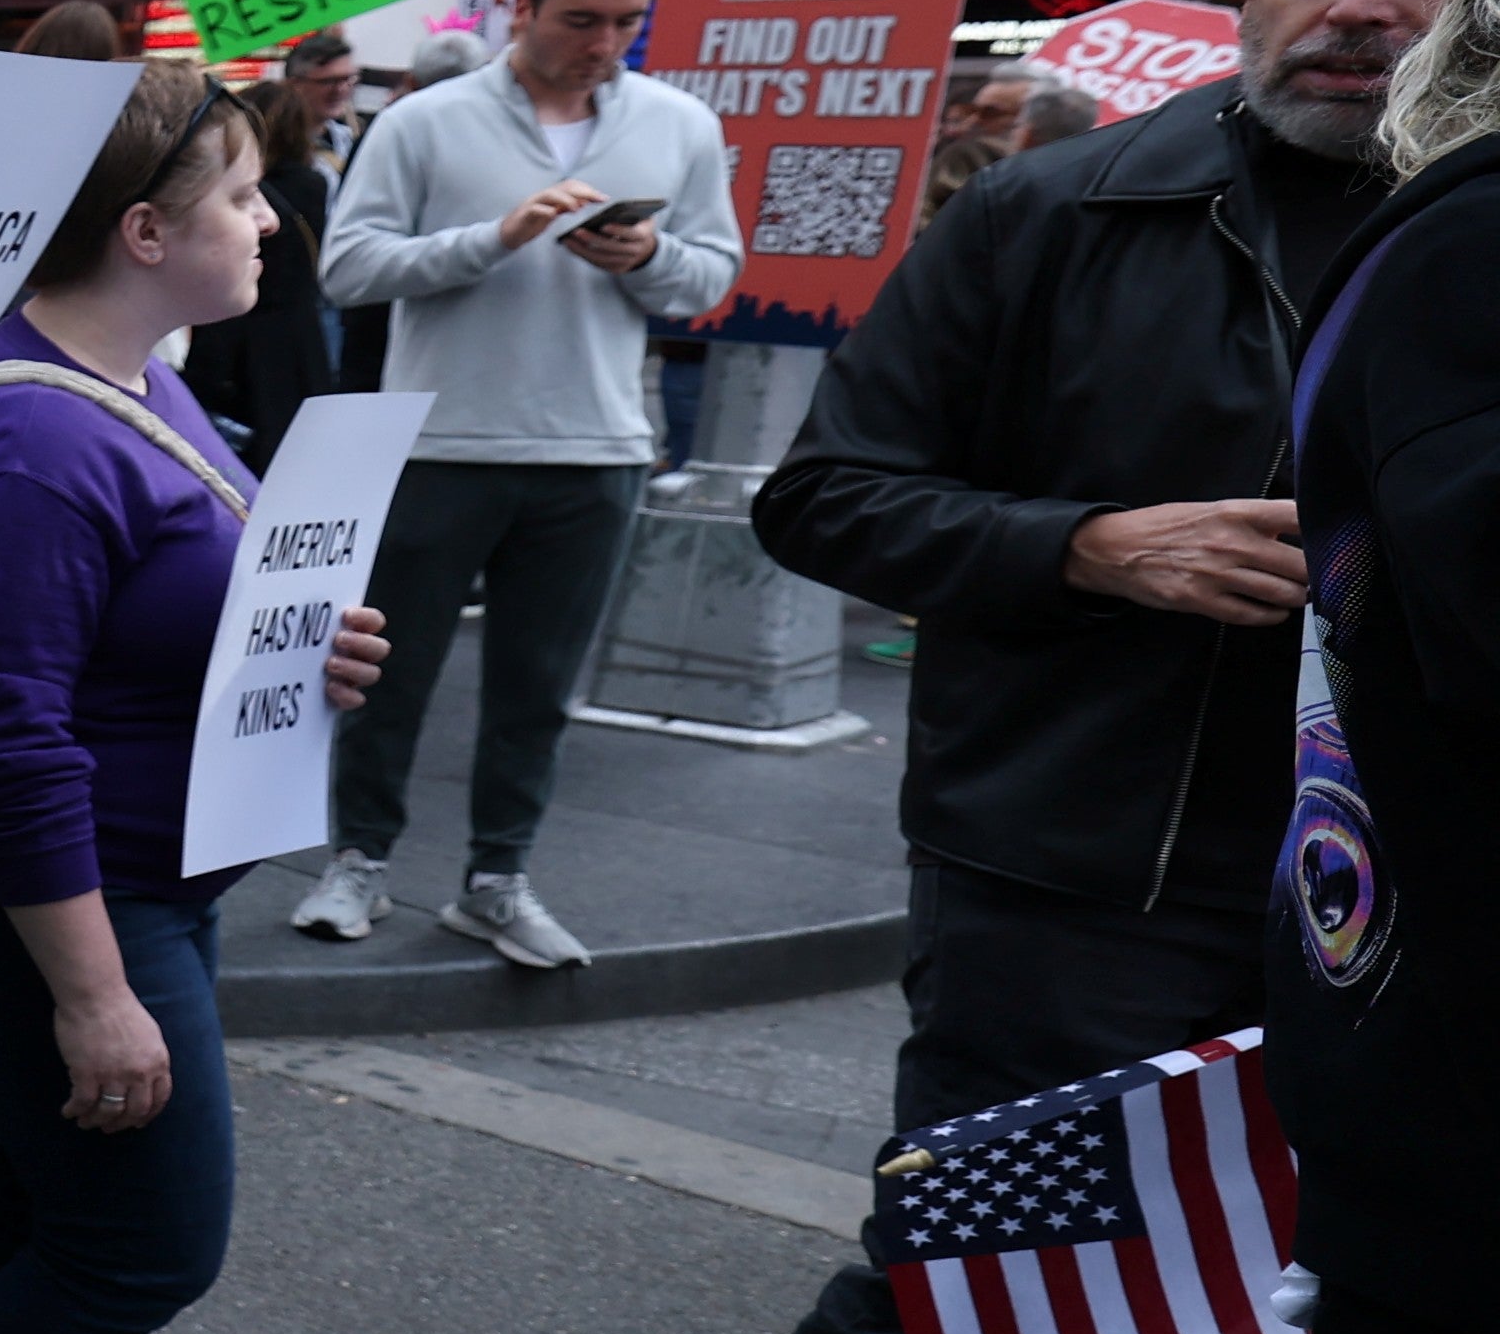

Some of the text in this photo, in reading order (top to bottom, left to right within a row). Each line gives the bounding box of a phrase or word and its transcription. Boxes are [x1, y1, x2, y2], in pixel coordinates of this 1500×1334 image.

[697, 17, 800, 66] FIND
[804, 14, 898, 66] OUT
[1065, 17, 1242, 84] STOP
[814, 68, 936, 117] NEXT
[256, 518, 359, 575] AMERICA
[245, 600, 333, 657] HAS NO
[233, 681, 305, 739] KINGS
